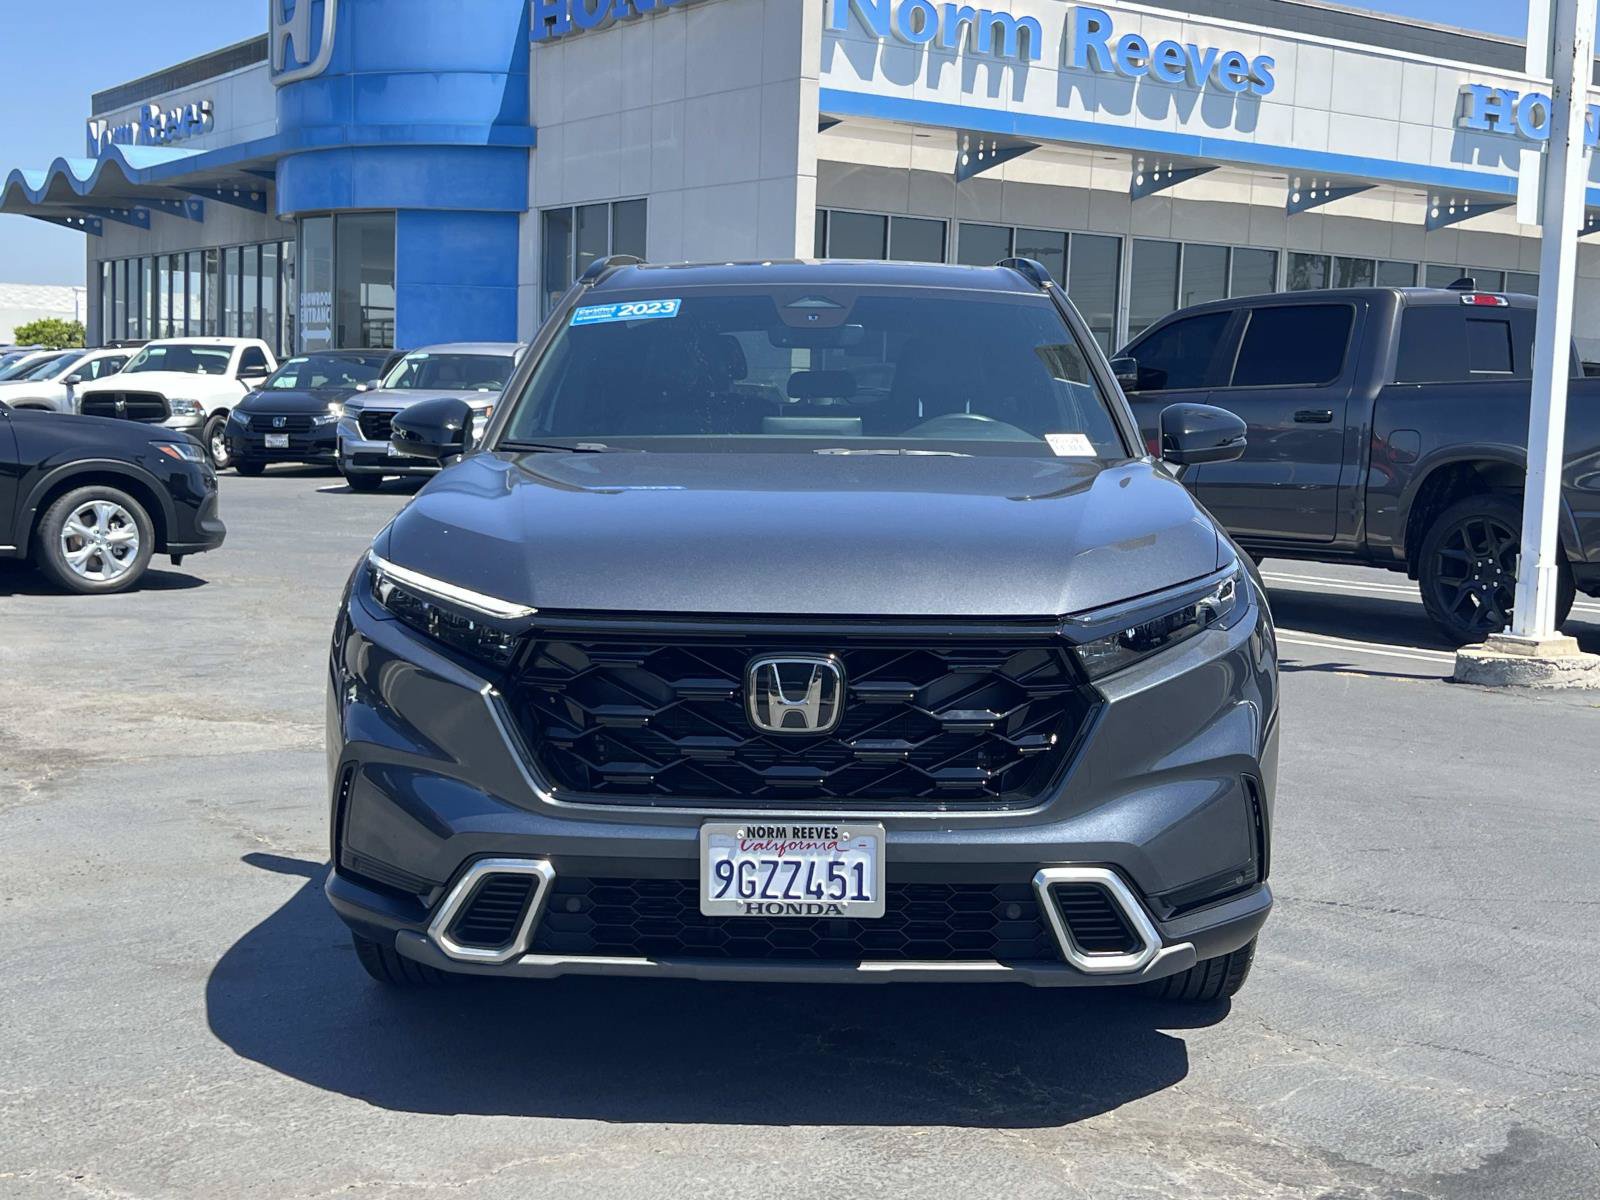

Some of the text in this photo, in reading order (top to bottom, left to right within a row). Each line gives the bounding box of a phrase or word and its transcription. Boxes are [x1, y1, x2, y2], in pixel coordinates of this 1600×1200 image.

[827, 0, 1276, 96] Norm Reeves
[141, 100, 214, 145] Reeves
[300, 307, 331, 323] ENTRANC
[618, 302, 676, 316] 2023
[746, 826, 839, 839] NORM REEVES
[740, 839, 850, 858] California
[715, 859, 870, 901] 9GZZ451
[744, 902, 844, 915] HONDA
